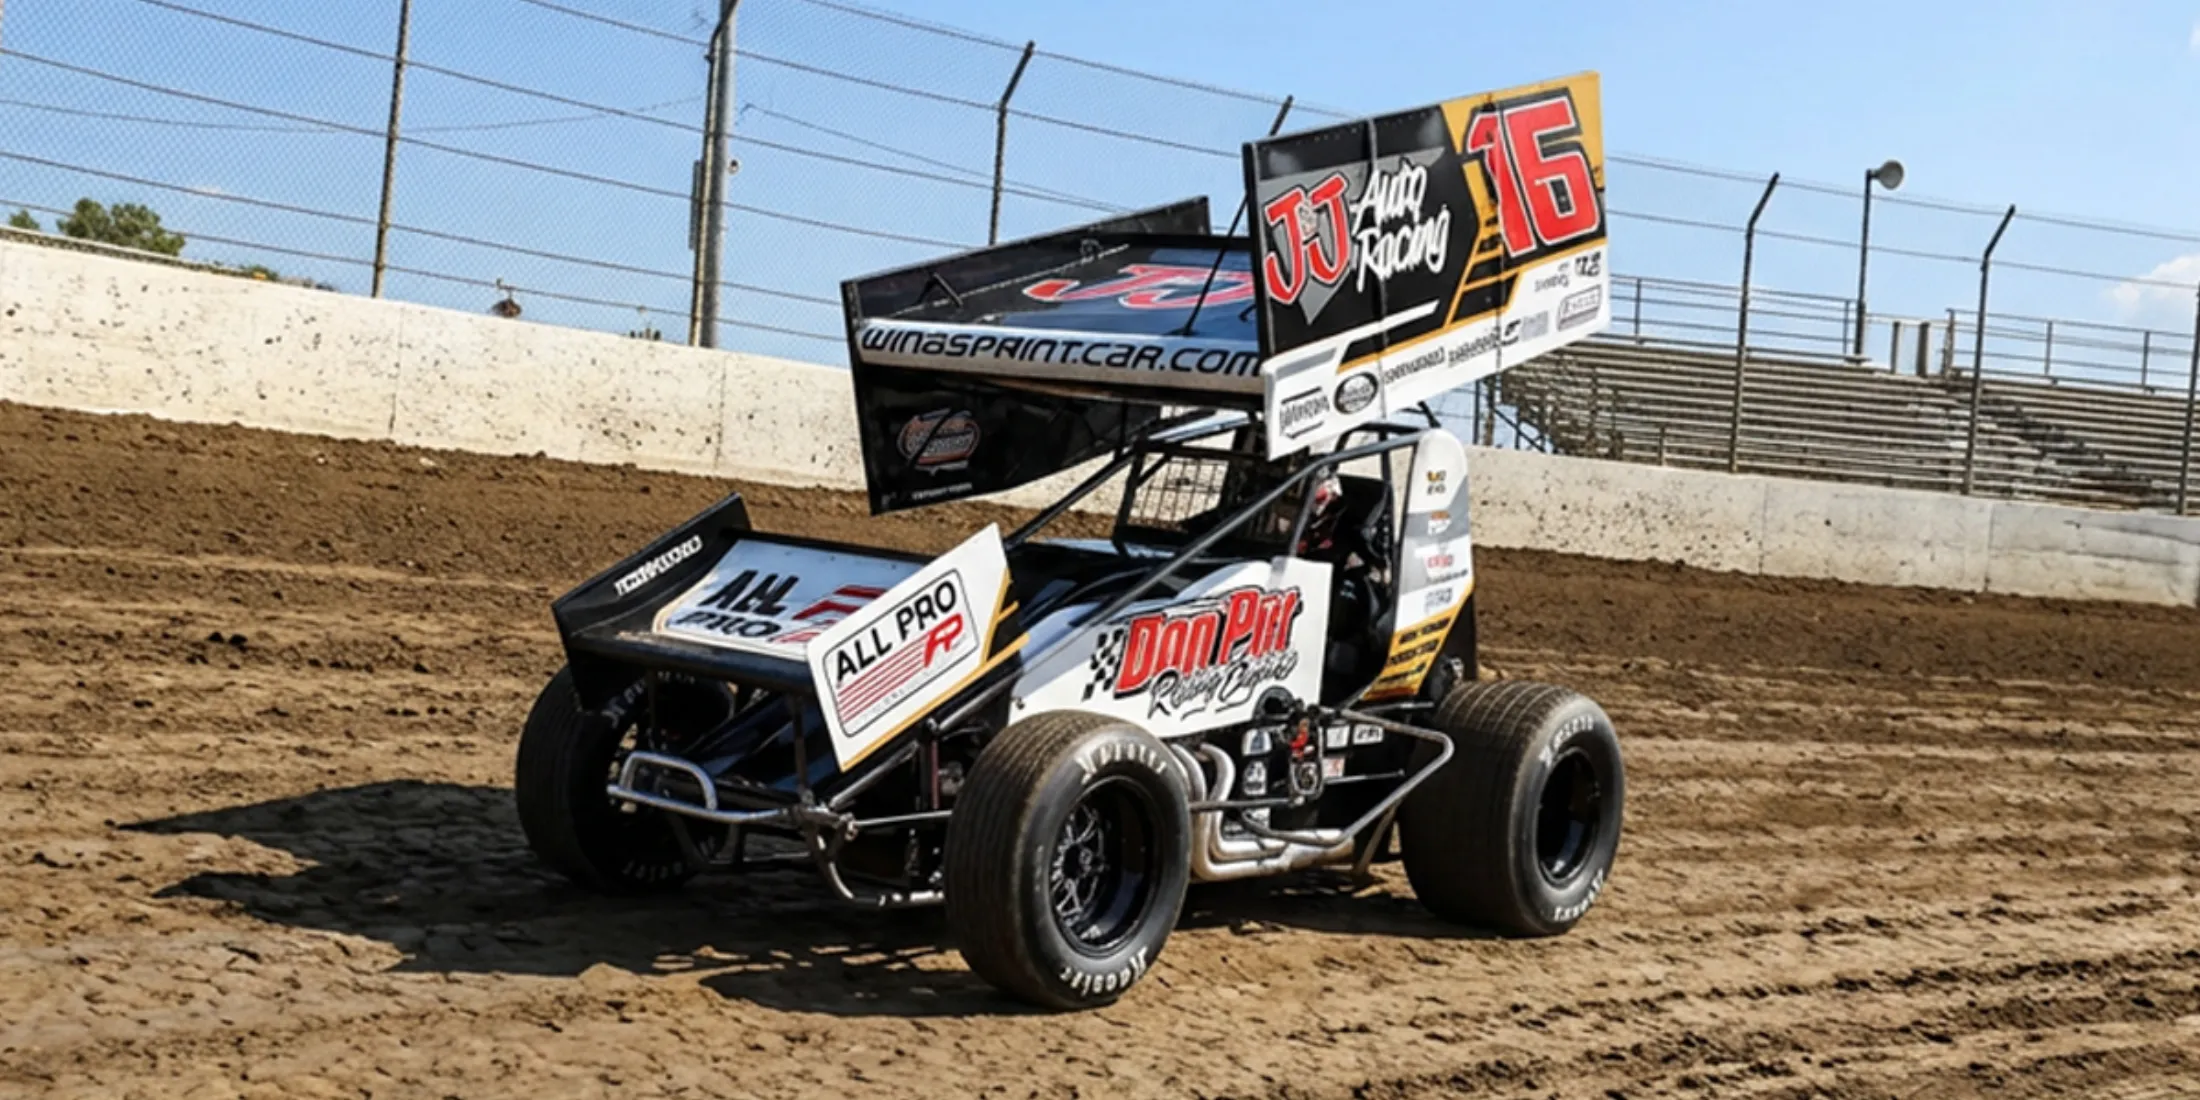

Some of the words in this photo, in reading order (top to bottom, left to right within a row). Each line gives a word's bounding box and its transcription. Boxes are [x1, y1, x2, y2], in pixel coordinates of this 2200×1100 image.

[1351, 162, 1428, 234] Auto
[1468, 97, 1600, 258] 16
[1355, 204, 1451, 292] Racing
[836, 627, 893, 682] ALL
[895, 580, 957, 641] PRO
[1114, 611, 1221, 699] Don
